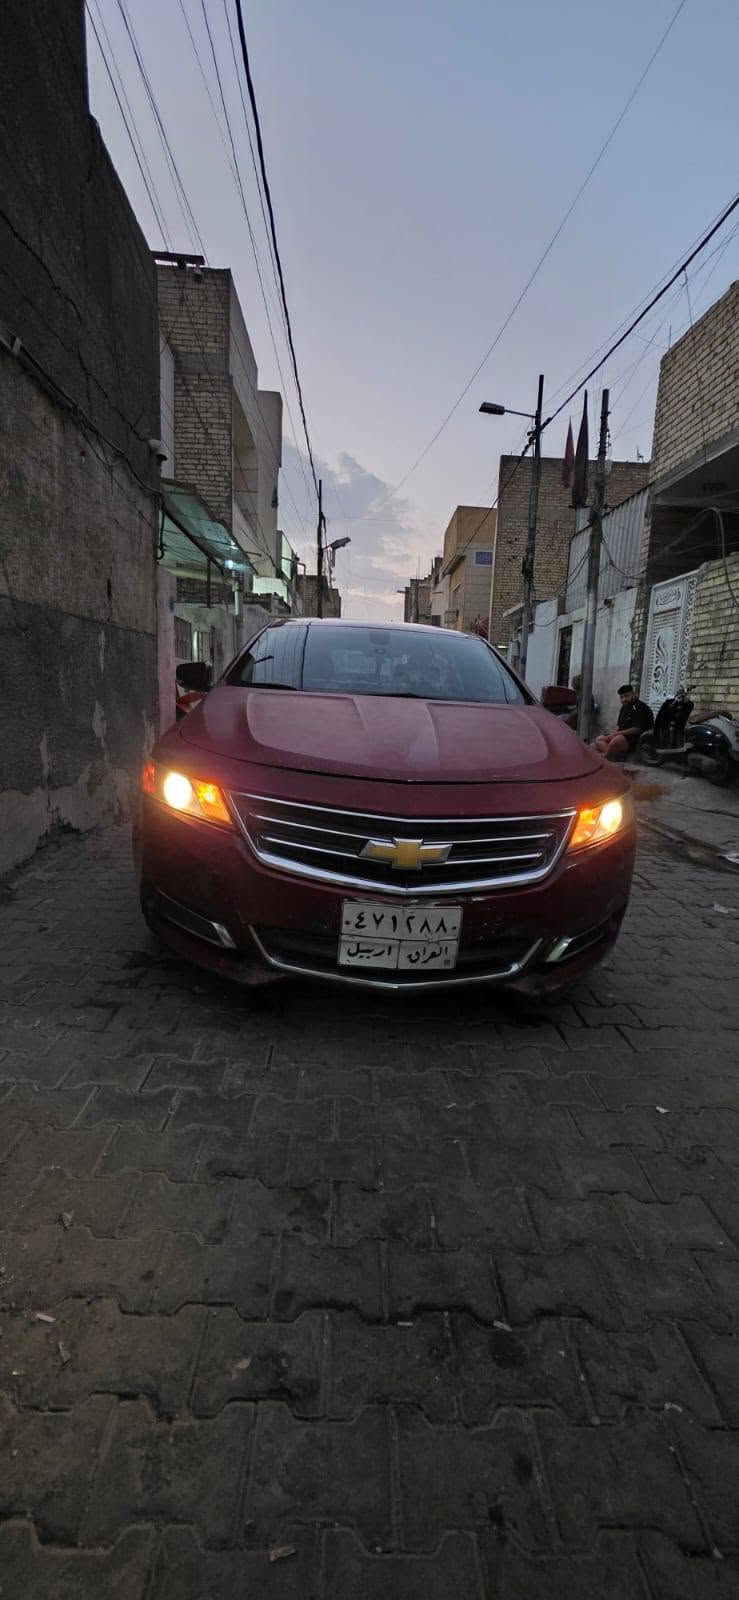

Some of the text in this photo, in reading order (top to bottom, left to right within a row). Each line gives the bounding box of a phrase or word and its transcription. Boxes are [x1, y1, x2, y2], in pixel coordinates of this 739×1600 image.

[354, 911, 447, 934] ٤٧١٢٨٨
[347, 943, 449, 964] العراق اربيل
